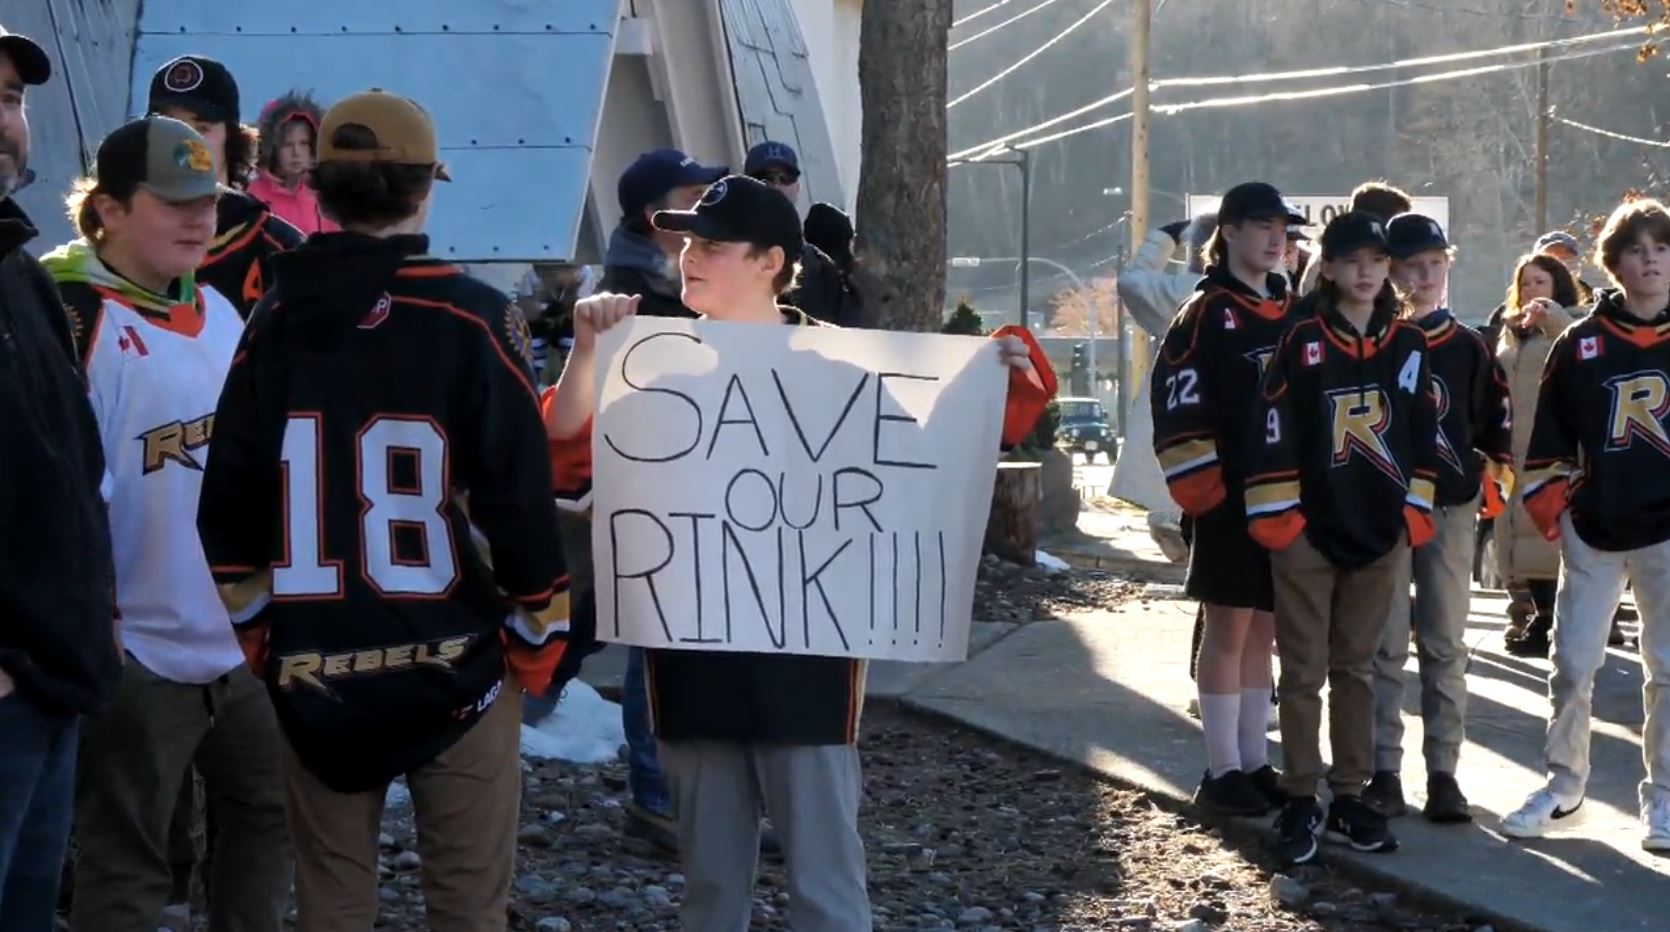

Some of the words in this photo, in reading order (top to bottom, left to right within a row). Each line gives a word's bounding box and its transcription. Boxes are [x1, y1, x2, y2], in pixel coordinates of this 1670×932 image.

[604, 332, 939, 470] SAVE
[1166, 368, 1200, 411] 22
[1398, 350, 1422, 395] A
[270, 411, 461, 600] 18
[725, 466, 884, 533] OUR
[610, 508, 946, 652] RINK!!!!
